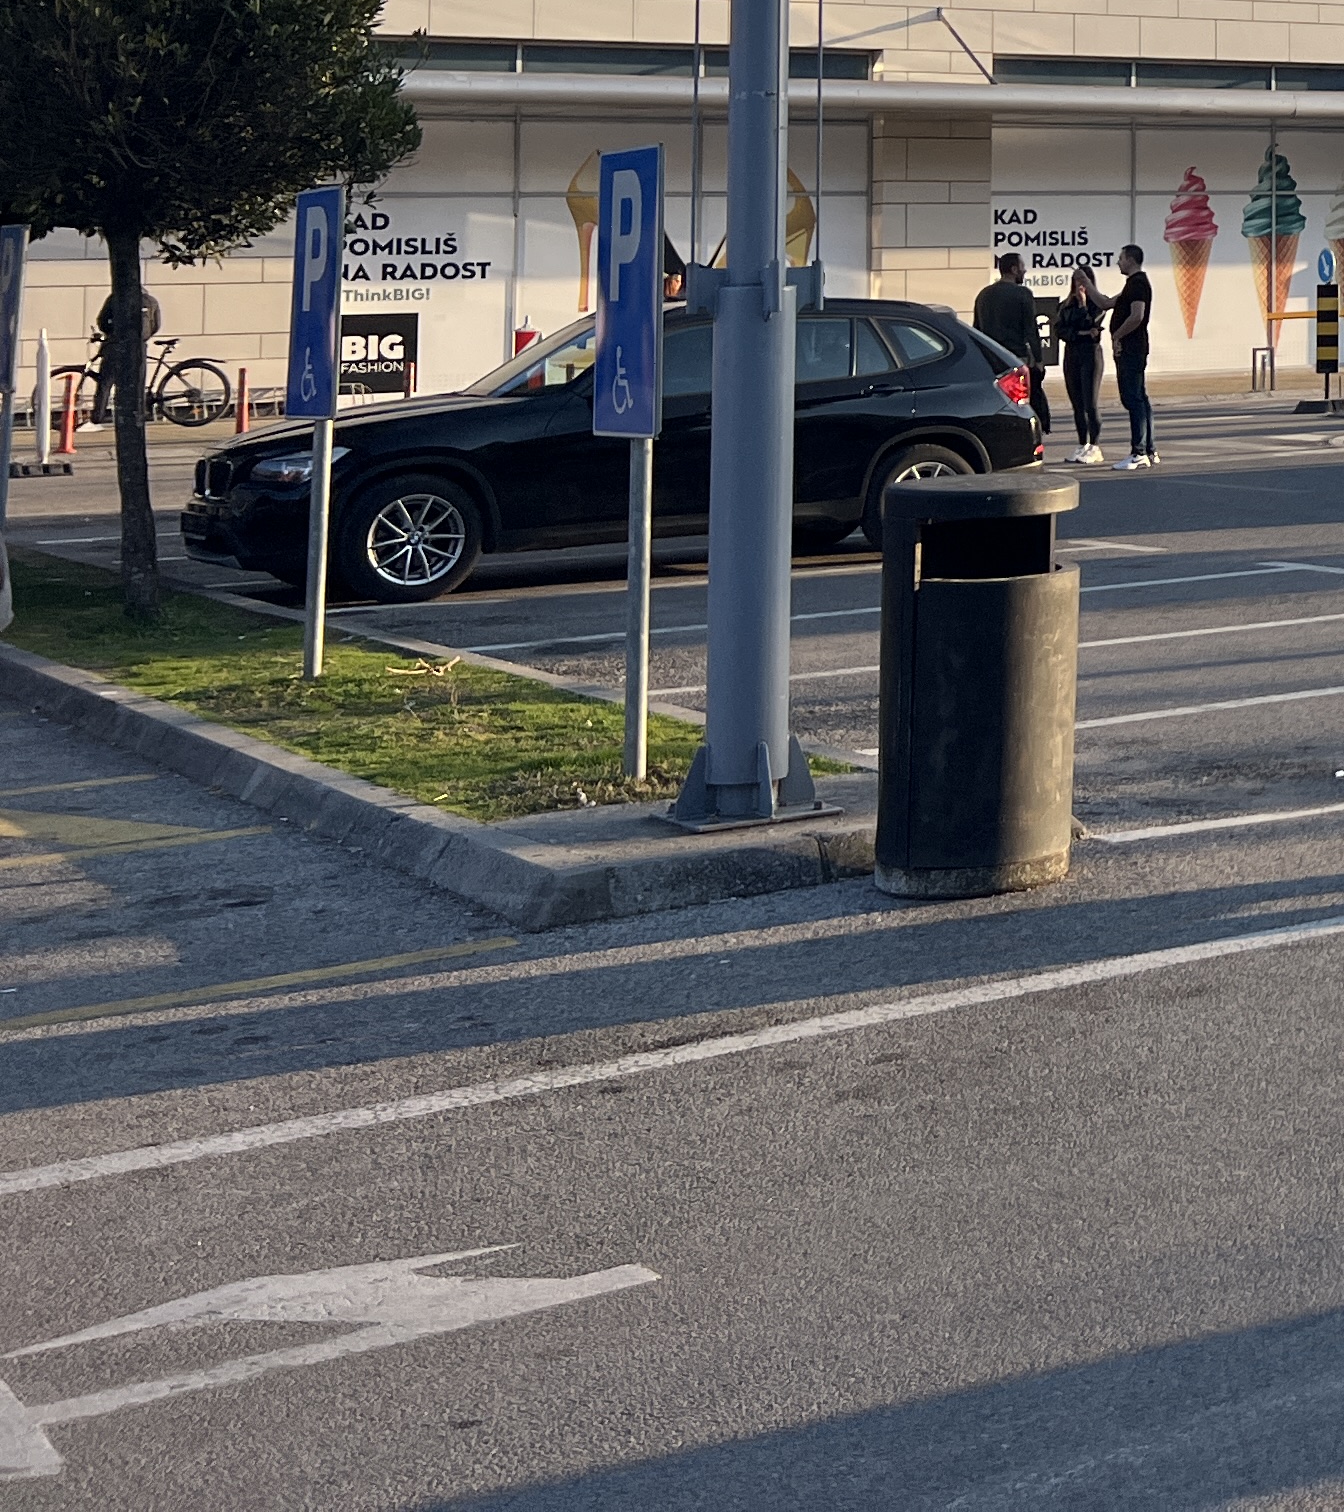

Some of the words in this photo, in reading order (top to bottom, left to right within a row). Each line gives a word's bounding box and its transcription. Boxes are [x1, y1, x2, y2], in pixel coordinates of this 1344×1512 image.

[345, 212, 390, 231] AD
[994, 209, 1038, 225] KAD
[342, 232, 458, 256] OMISLIŠ
[609, 168, 643, 302] P
[994, 226, 1089, 248] POMISLIŠ
[302, 205, 328, 312] P
[1032, 252, 1114, 268] RADOST
[381, 261, 491, 281] RADOST
[341, 334, 404, 361] BIG
[340, 361, 404, 374] FASHION
